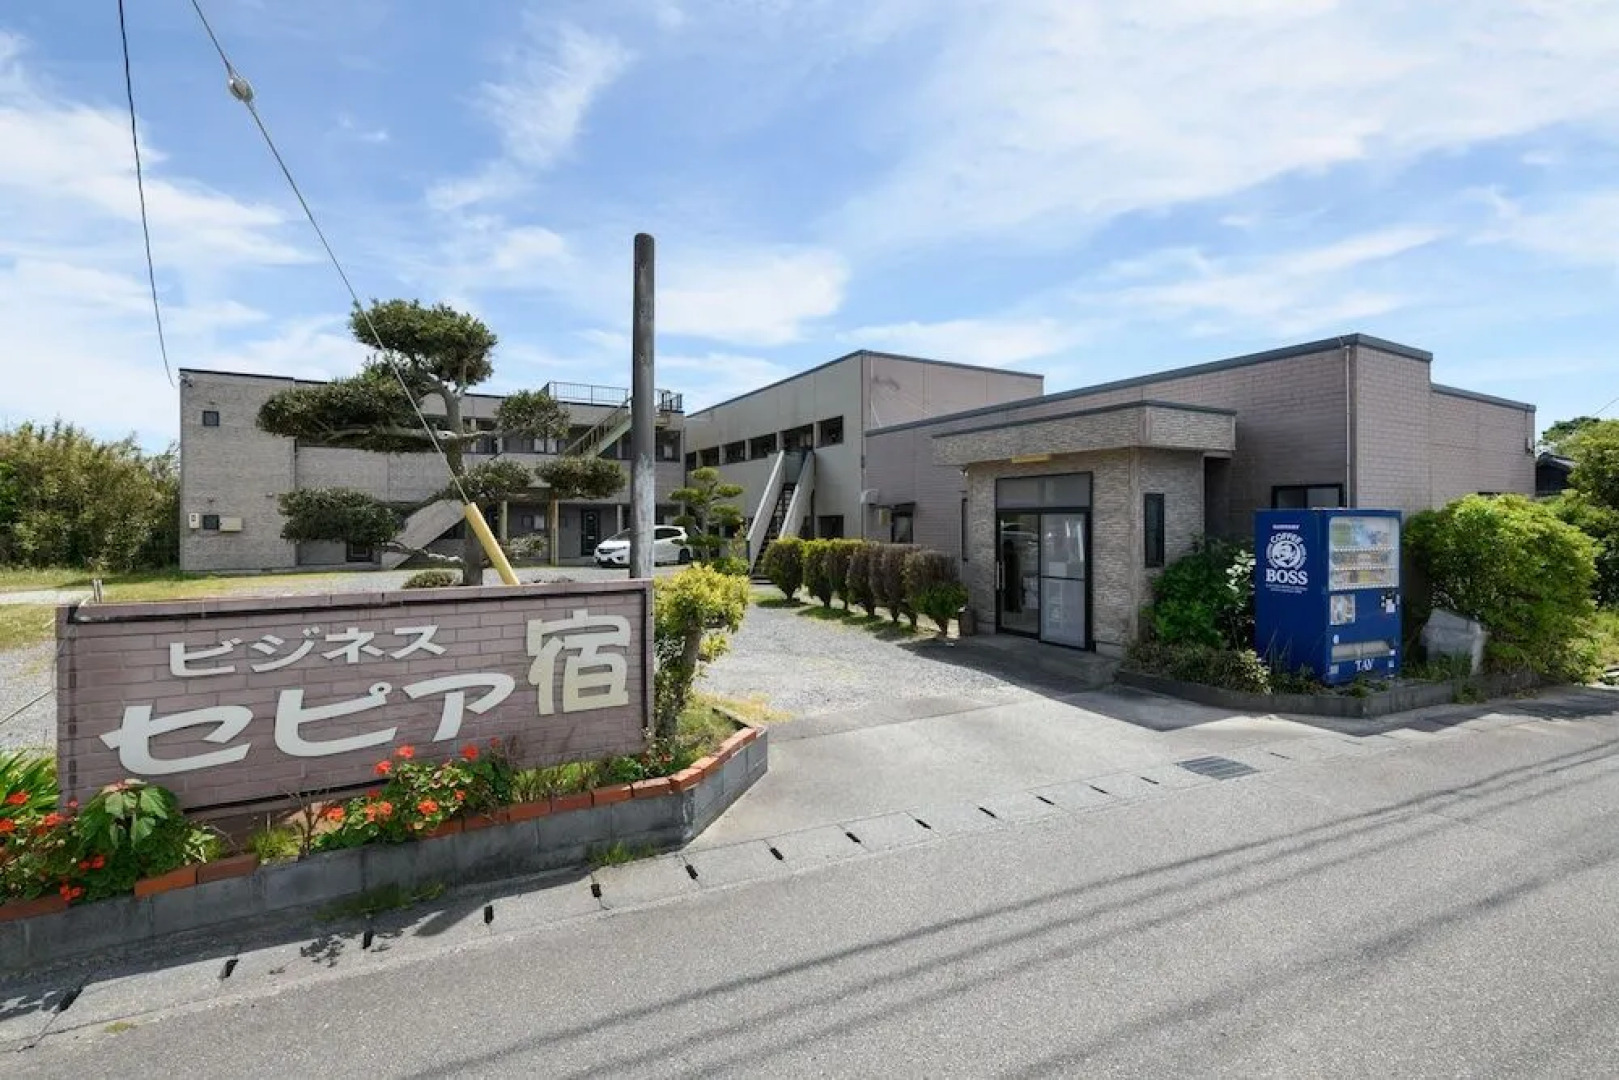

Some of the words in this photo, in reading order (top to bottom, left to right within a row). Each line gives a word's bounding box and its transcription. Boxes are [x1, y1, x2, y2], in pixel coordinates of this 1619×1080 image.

[1266, 569, 1308, 584] BOSS
[169, 624, 446, 676] ビジネス
[527, 609, 631, 715] 宿
[100, 673, 516, 775] セピア
